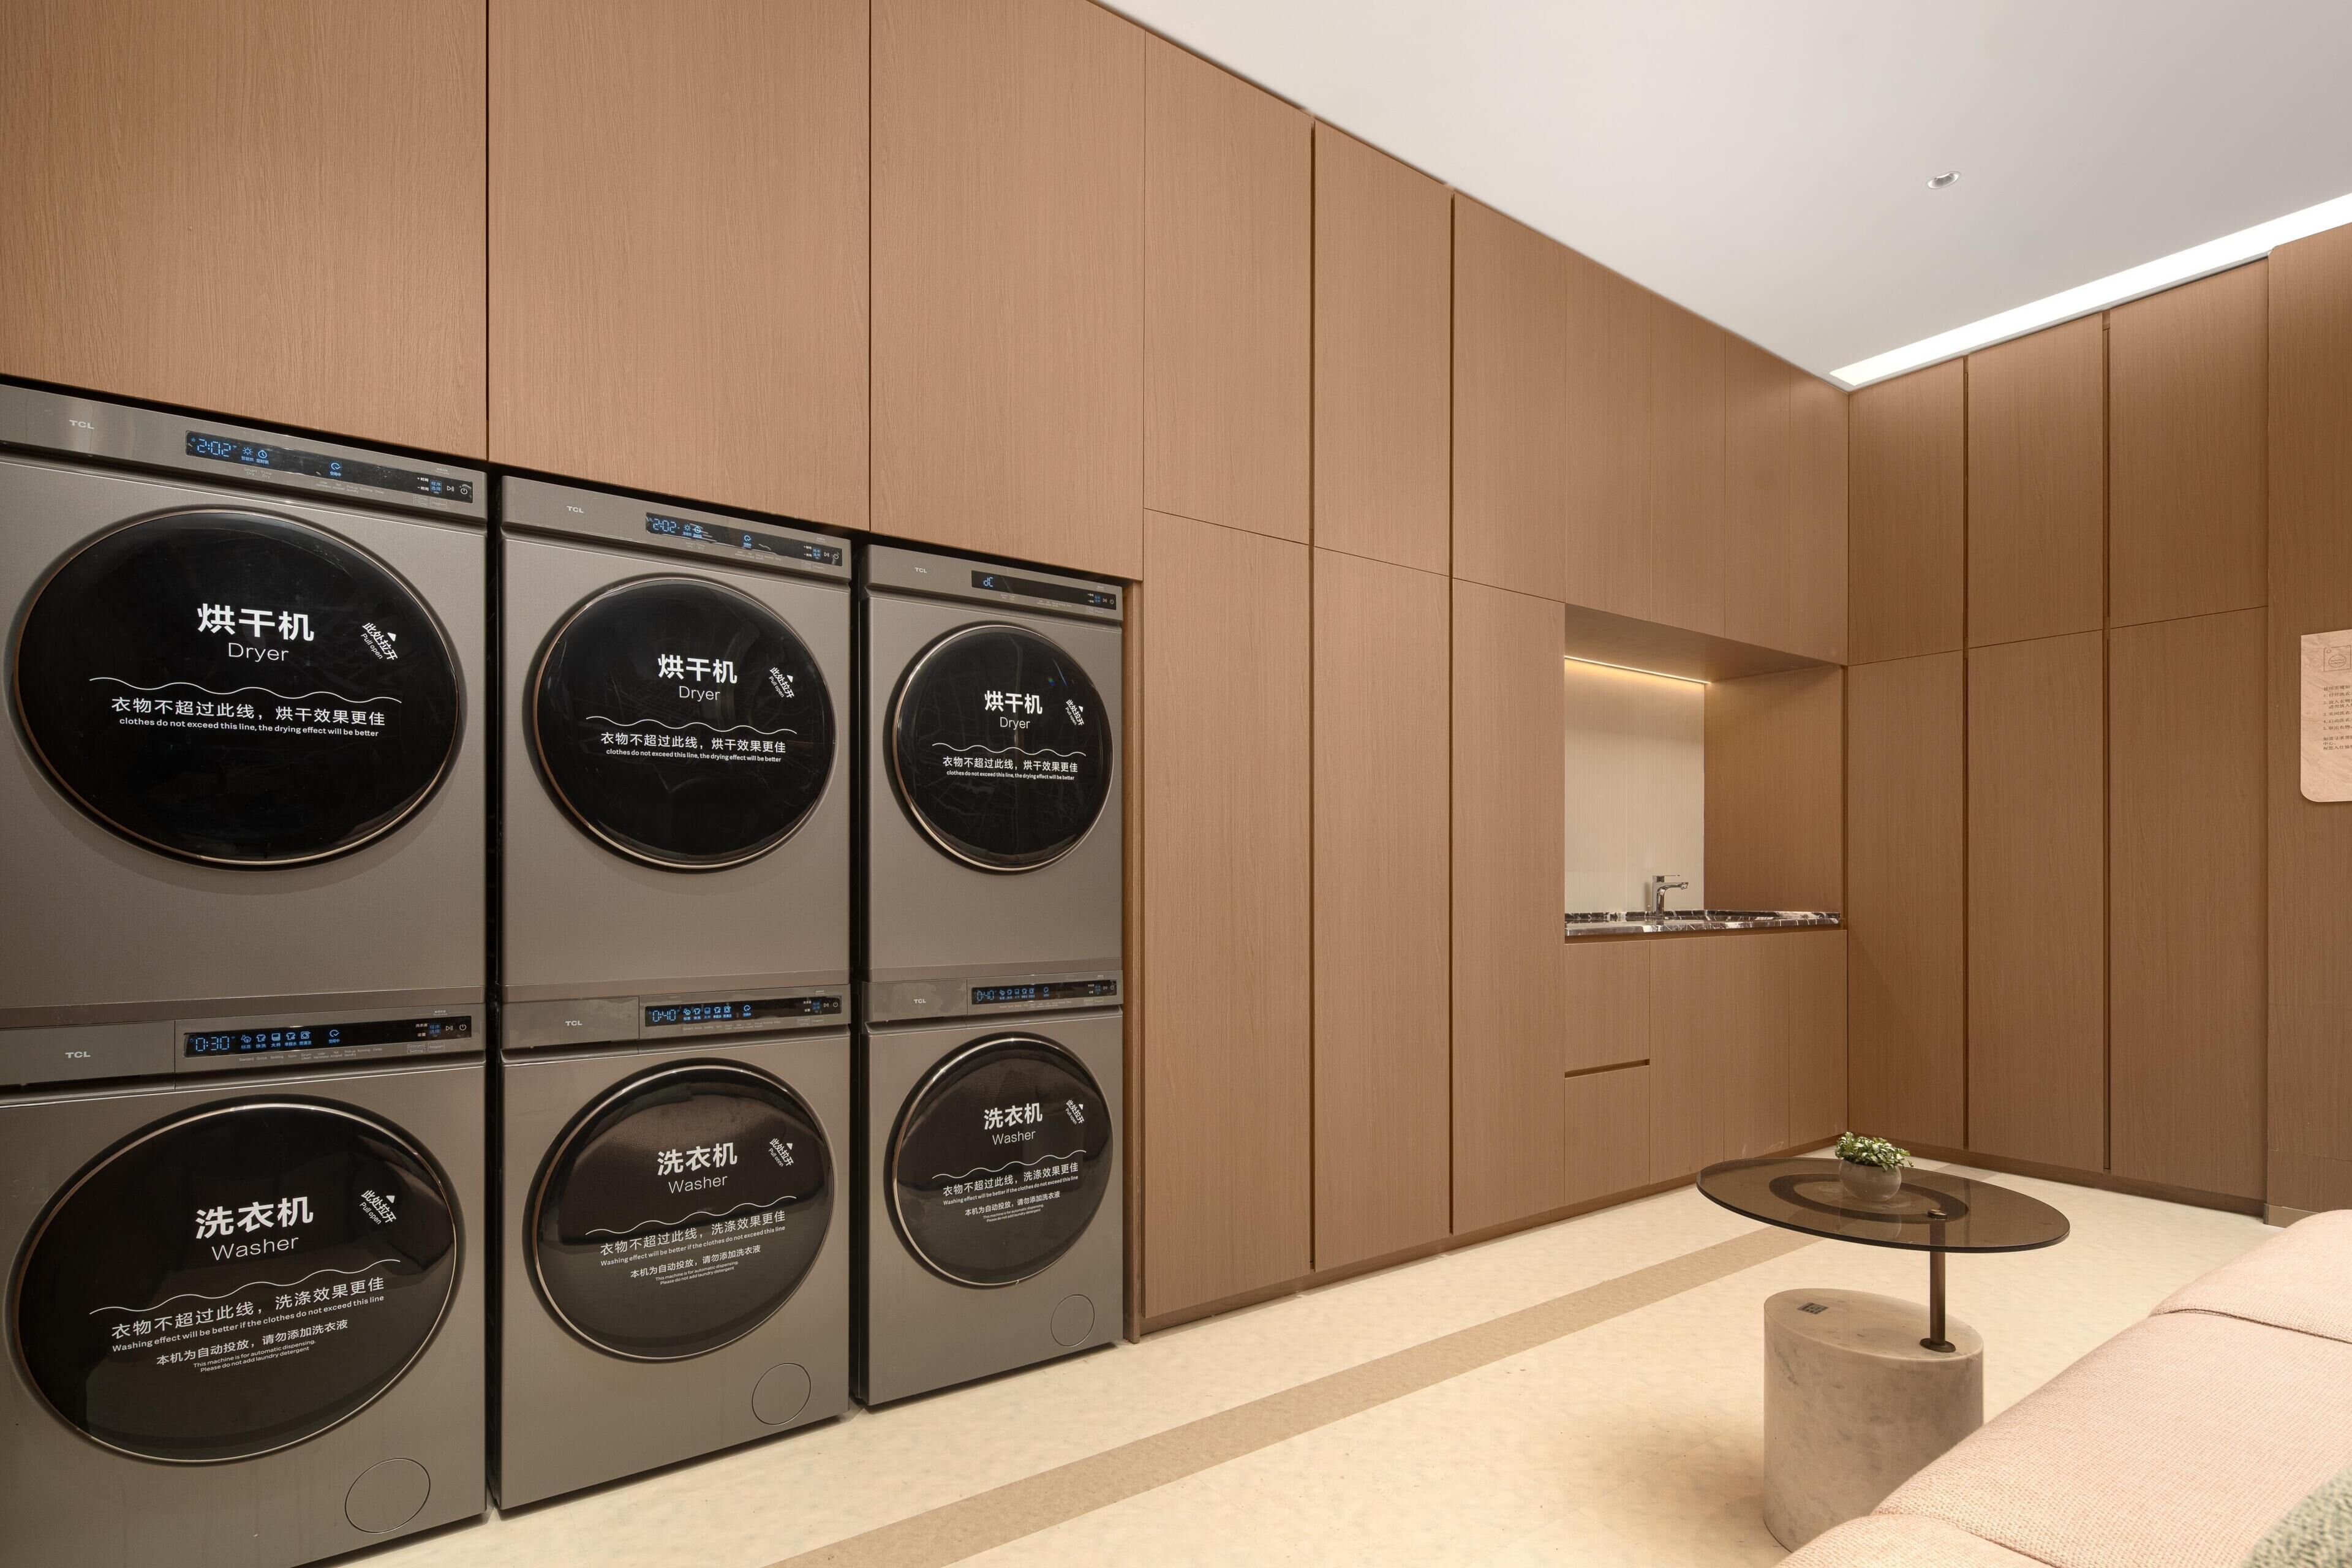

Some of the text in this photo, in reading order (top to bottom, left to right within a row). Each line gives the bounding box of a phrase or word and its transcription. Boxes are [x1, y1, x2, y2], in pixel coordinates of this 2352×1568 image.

[69, 420, 94, 429] TCL
[197, 438, 231, 458] 2:02
[653, 518, 676, 533] 2:02
[197, 603, 314, 641] 烘干机
[228, 643, 289, 662] Dryer
[360, 633, 383, 659] Pull open
[362, 622, 398, 660] 此处拉开
[657, 654, 737, 684] 烘干机
[679, 685, 720, 702] Dryer
[769, 667, 794, 698] 此处拉开
[769, 676, 785, 698] Pull open
[111, 696, 385, 726] 衣物不超过此线，烘干效果更佳
[984, 690, 1042, 714] 烘干机
[274, 725, 301, 734] drying
[1000, 717, 1030, 730] Dryer
[601, 732, 786, 753] 衣物不超过此线，烘干效果更佳
[652, 1009, 676, 1022] 0:40
[195, 1036, 230, 1052] 0:30
[984, 1102, 1042, 1130] 洗衣机
[992, 1131, 1036, 1145] Washer
[657, 1142, 737, 1176] 洗衣机
[768, 1148, 777, 1158] Pull
[668, 1176, 728, 1194] Washer
[195, 1196, 314, 1239] 洗衣机
[360, 1202, 382, 1224] Pull open
[361, 1190, 397, 1223] 此处拉开
[600, 1210, 785, 1256] 衣物不超过此线，洗涤效果更佳
[211, 1237, 299, 1261] Washer
[600, 1257, 628, 1266] Washing
[629, 1253, 647, 1261] effect
[703, 1238, 725, 1247] clothes
[744, 1230, 764, 1238] exceed
[630, 1245, 761, 1278] 本机为自动投放，请勿添加洗衣液
[111, 1276, 384, 1339] 衣物不超过此线，洗涤效果更佳
[112, 1340, 153, 1352] Washing
[154, 1334, 181, 1344] effect
[182, 1330, 198, 1340] will
[212, 1324, 238, 1334] better
[263, 1314, 295, 1324] clothes
[323, 1301, 352, 1312] exceed
[157, 1319, 348, 1365] 本机为自动投放，请勿添加洗衣液
[279, 1346, 309, 1356] detergent
[207, 1357, 234, 1365] machine
[251, 1347, 282, 1357] automatic
